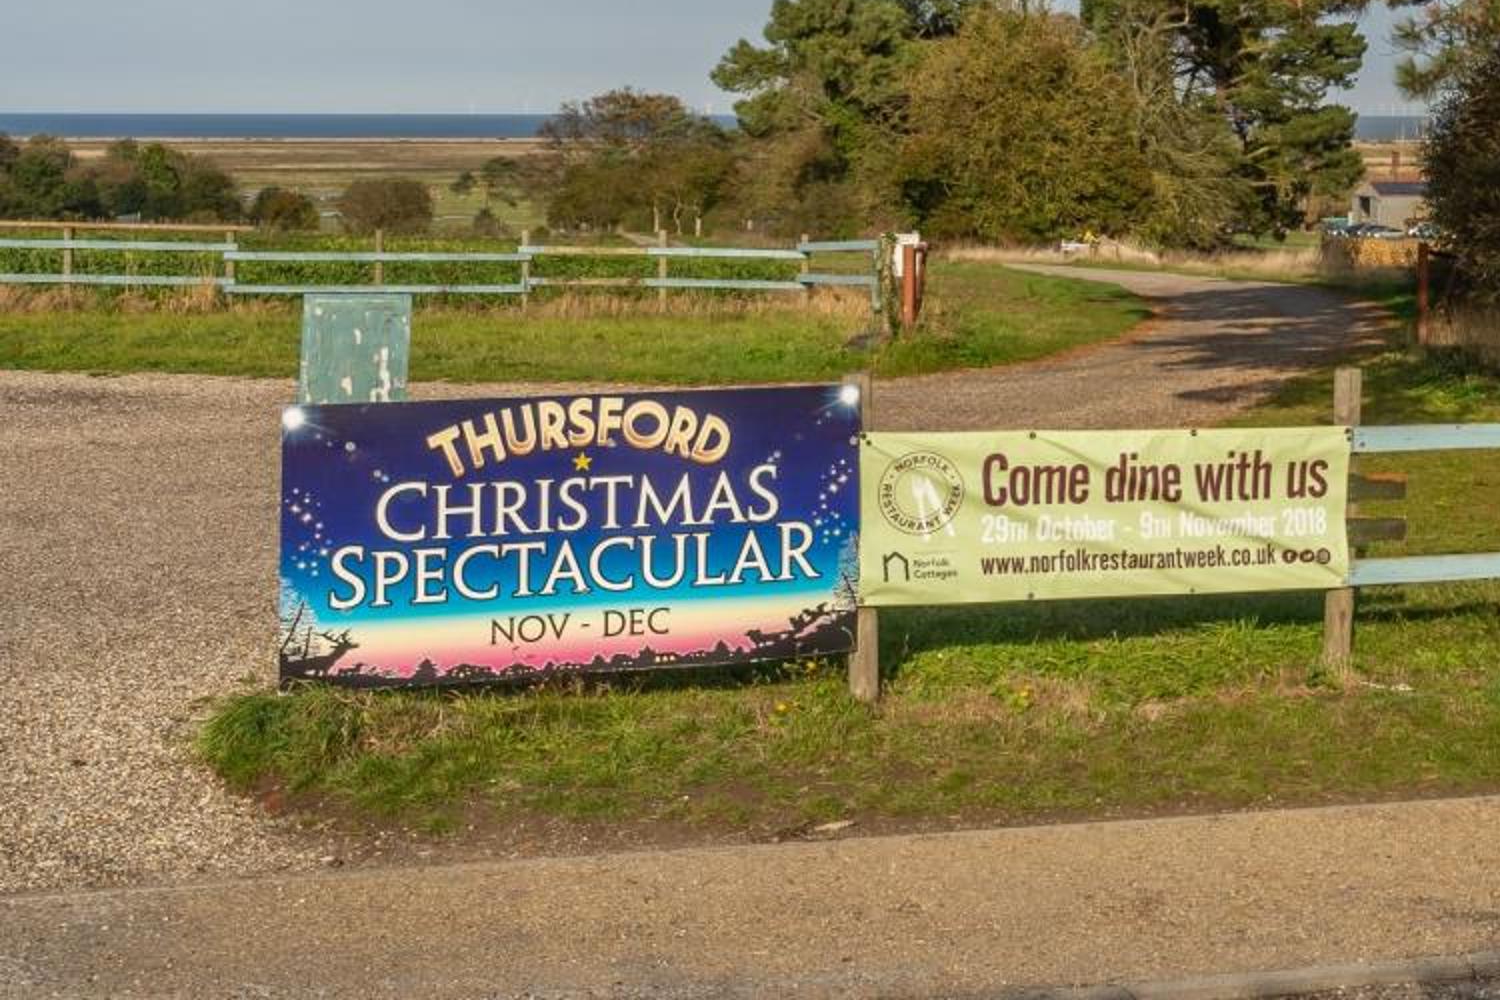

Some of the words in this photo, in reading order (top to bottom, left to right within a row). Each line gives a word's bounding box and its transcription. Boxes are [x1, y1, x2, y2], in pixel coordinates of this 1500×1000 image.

[427, 397, 731, 477] THURSFORD
[895, 456, 949, 472] NORFOLK
[982, 453, 1090, 507] Come
[1104, 452, 1182, 503] dine
[1194, 450, 1272, 502] with
[1287, 459, 1329, 499] us
[376, 464, 780, 542] CHRISTMAS
[882, 484, 941, 530] RESTAURANT
[1037, 514, 1116, 542] October
[1180, 510, 1276, 538] November
[1282, 506, 1327, 537] 2018
[328, 520, 823, 611] SPECTACULAR
[981, 544, 1276, 576] www.norfolkrestaurantweek.co.uk
[490, 613, 572, 645] NOV
[602, 607, 671, 636] DEC
